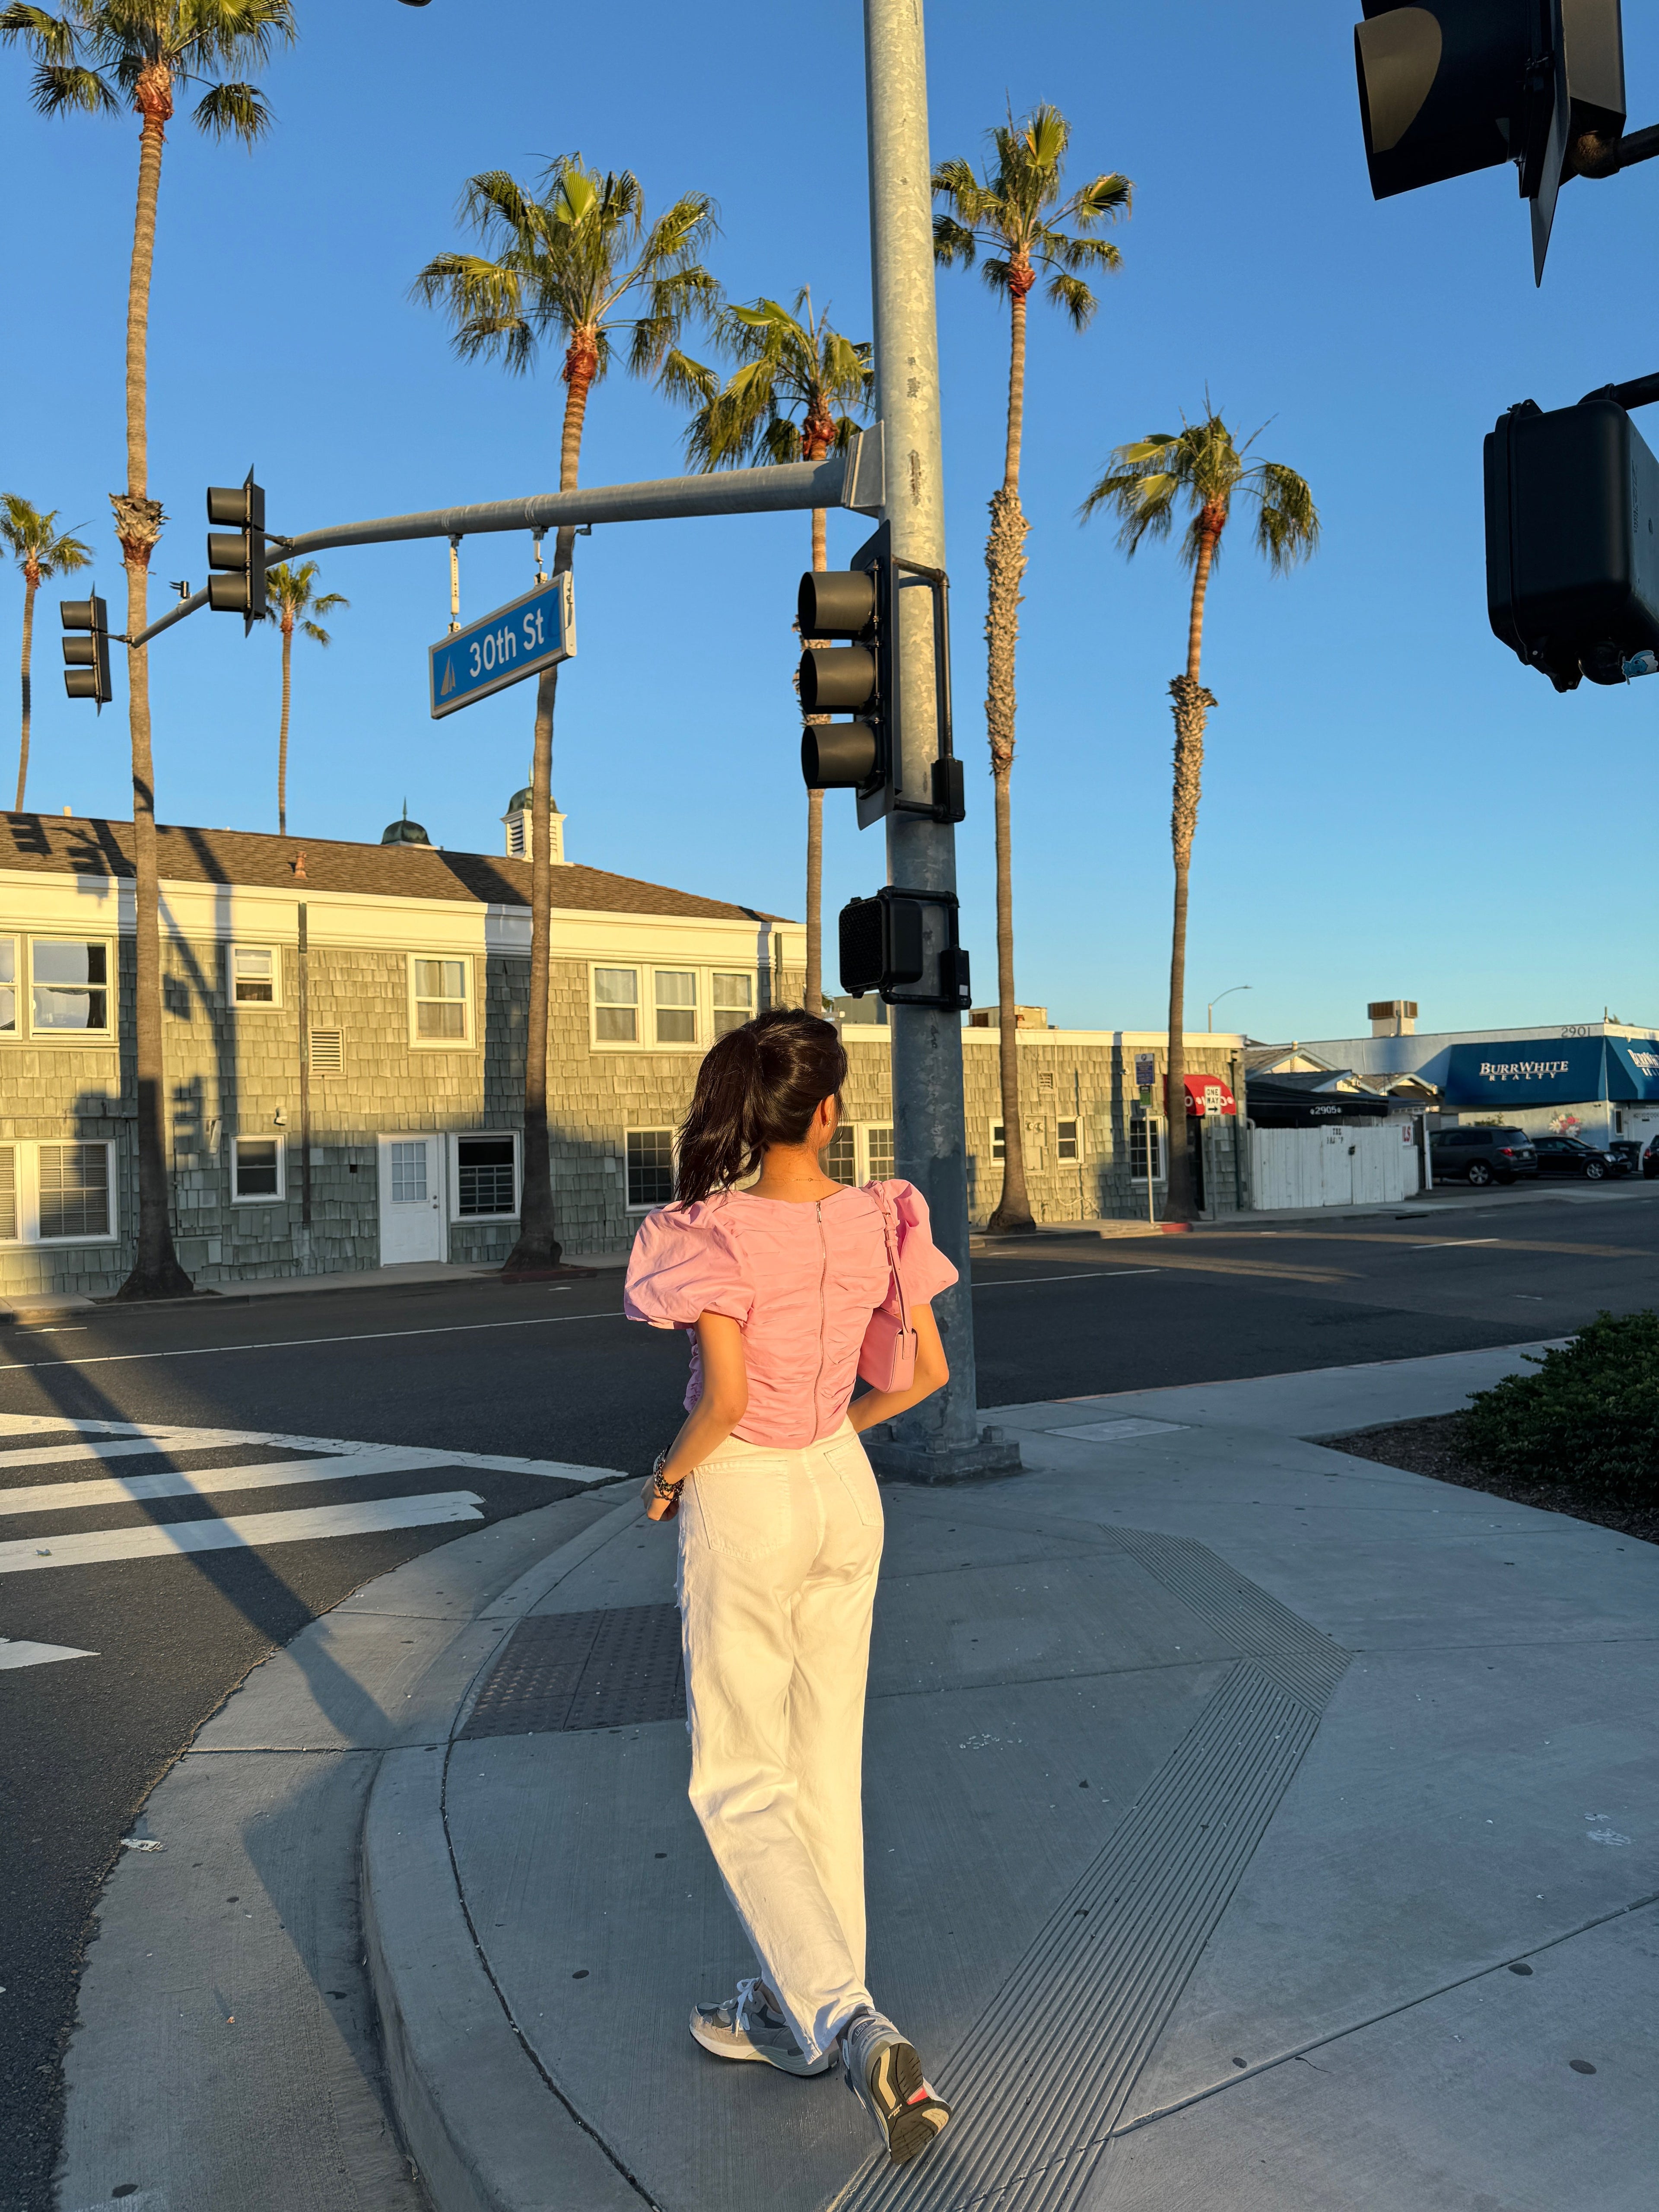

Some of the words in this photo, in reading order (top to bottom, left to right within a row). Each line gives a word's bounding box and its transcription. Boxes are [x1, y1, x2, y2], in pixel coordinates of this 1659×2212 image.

[469, 626, 516, 677] 30th
[523, 608, 544, 650] St
[1561, 1026, 1590, 1038] 2901
[1489, 1072, 1555, 1081] REALTY
[1315, 1105, 1337, 1115] 2905
[855, 2022, 868, 2037] USA
